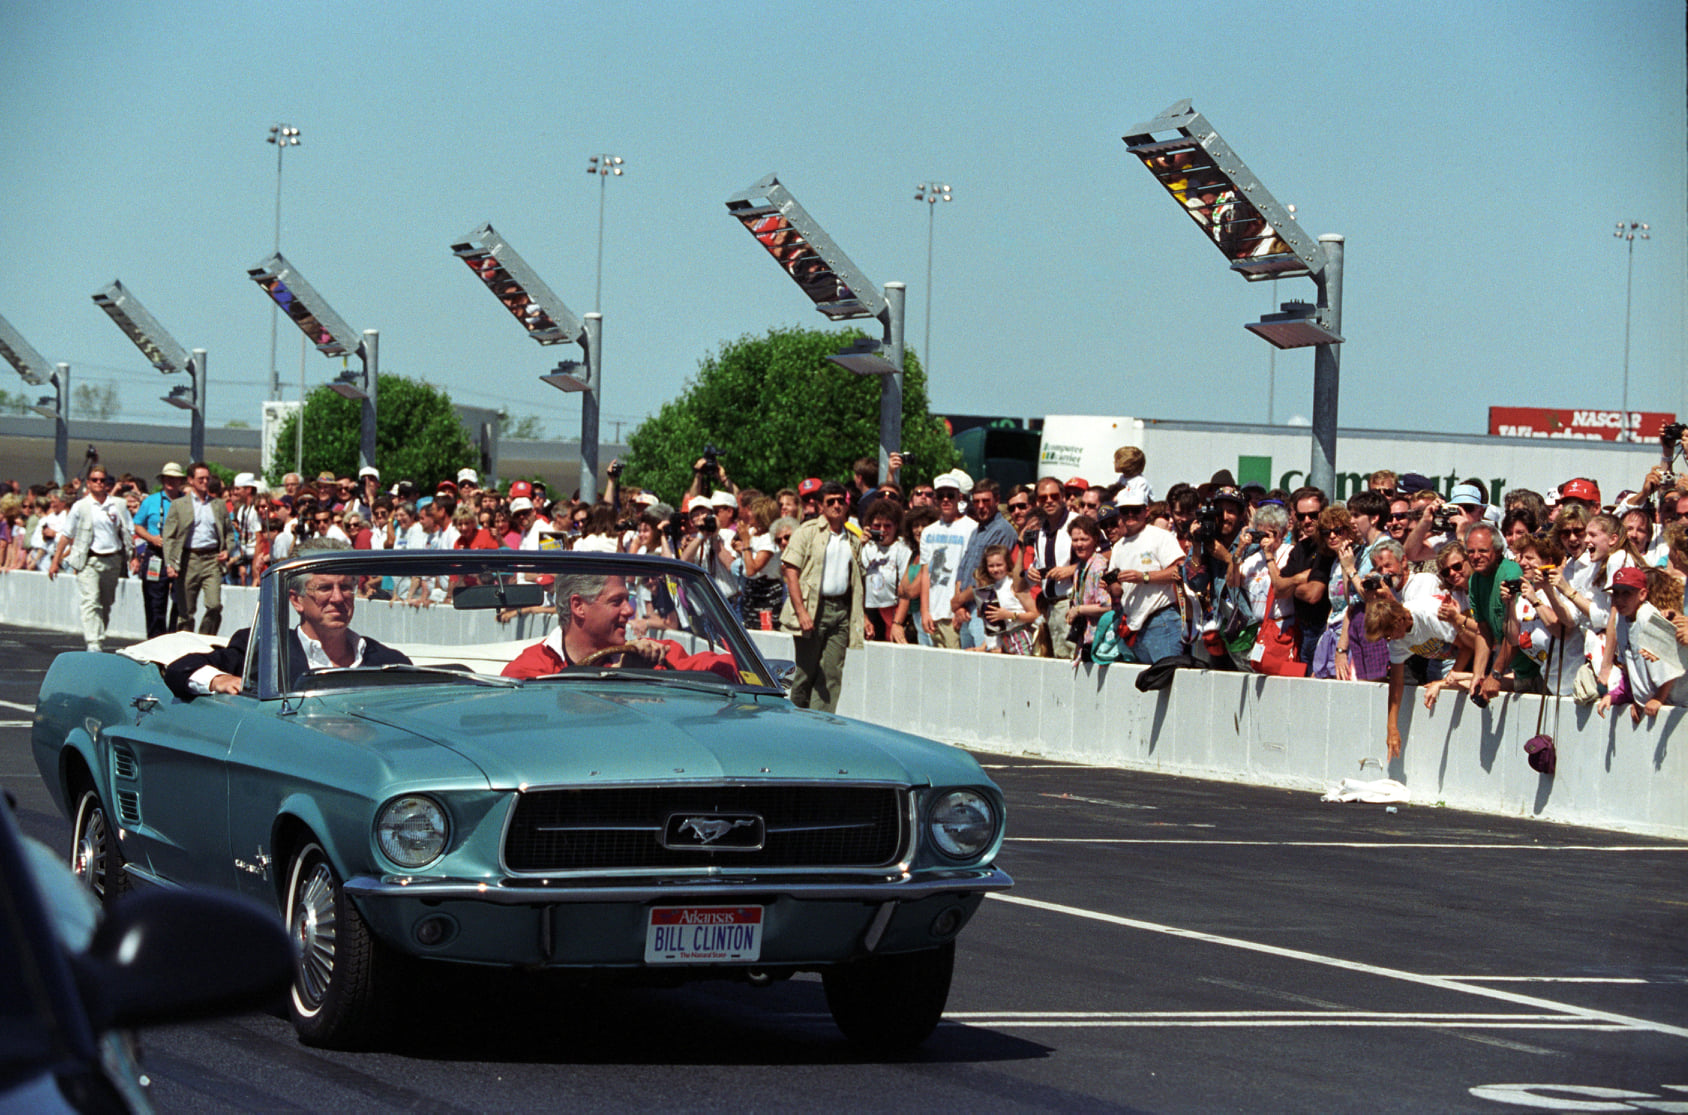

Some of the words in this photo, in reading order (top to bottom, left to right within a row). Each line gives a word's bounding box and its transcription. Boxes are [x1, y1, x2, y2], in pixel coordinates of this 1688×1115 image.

[1571, 411, 1642, 428] NASCAR
[1279, 467, 1506, 506] cmutr
[678, 909, 735, 924] Arkansas
[654, 926, 685, 951] BILL
[693, 925, 754, 951] CLINTON
